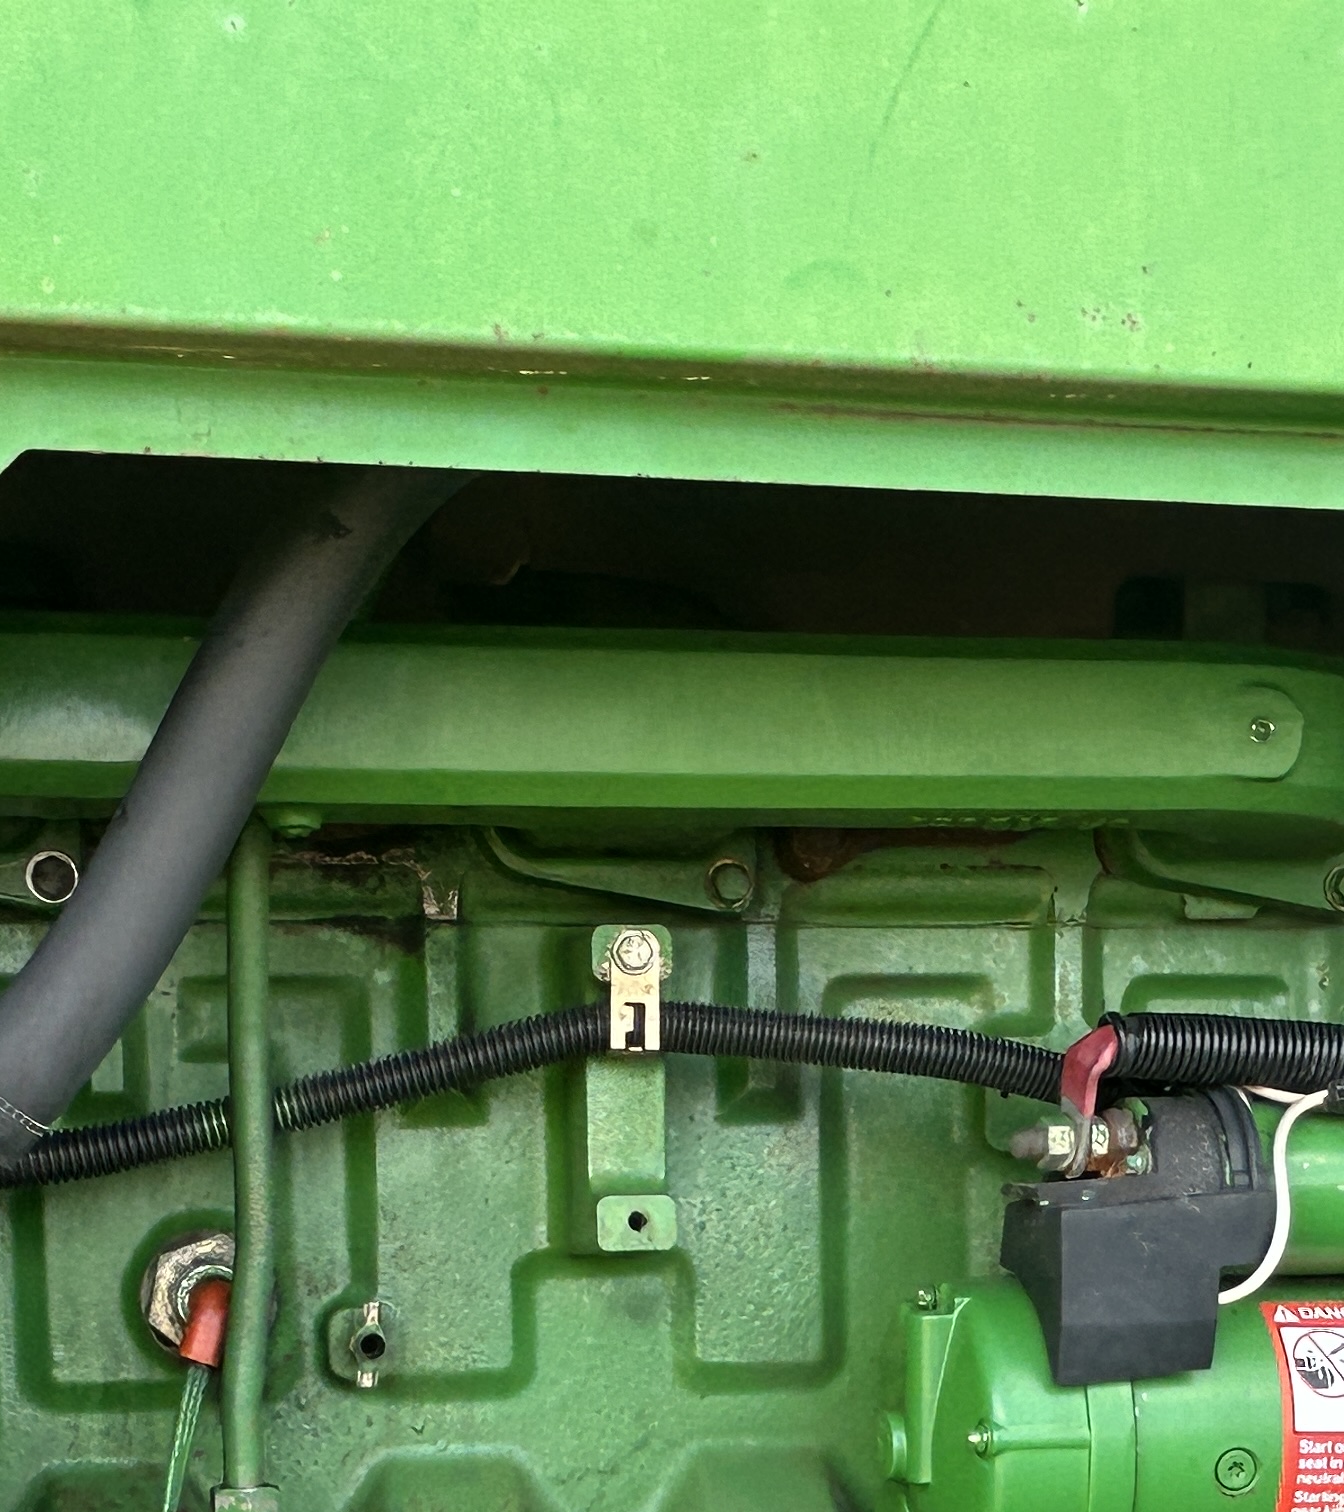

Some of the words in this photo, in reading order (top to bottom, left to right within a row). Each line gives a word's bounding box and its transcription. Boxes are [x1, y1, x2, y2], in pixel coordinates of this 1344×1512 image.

[1298, 1438, 1333, 1454] Start
[1297, 1457, 1328, 1470] seat
[1329, 1456, 1343, 1470] in
